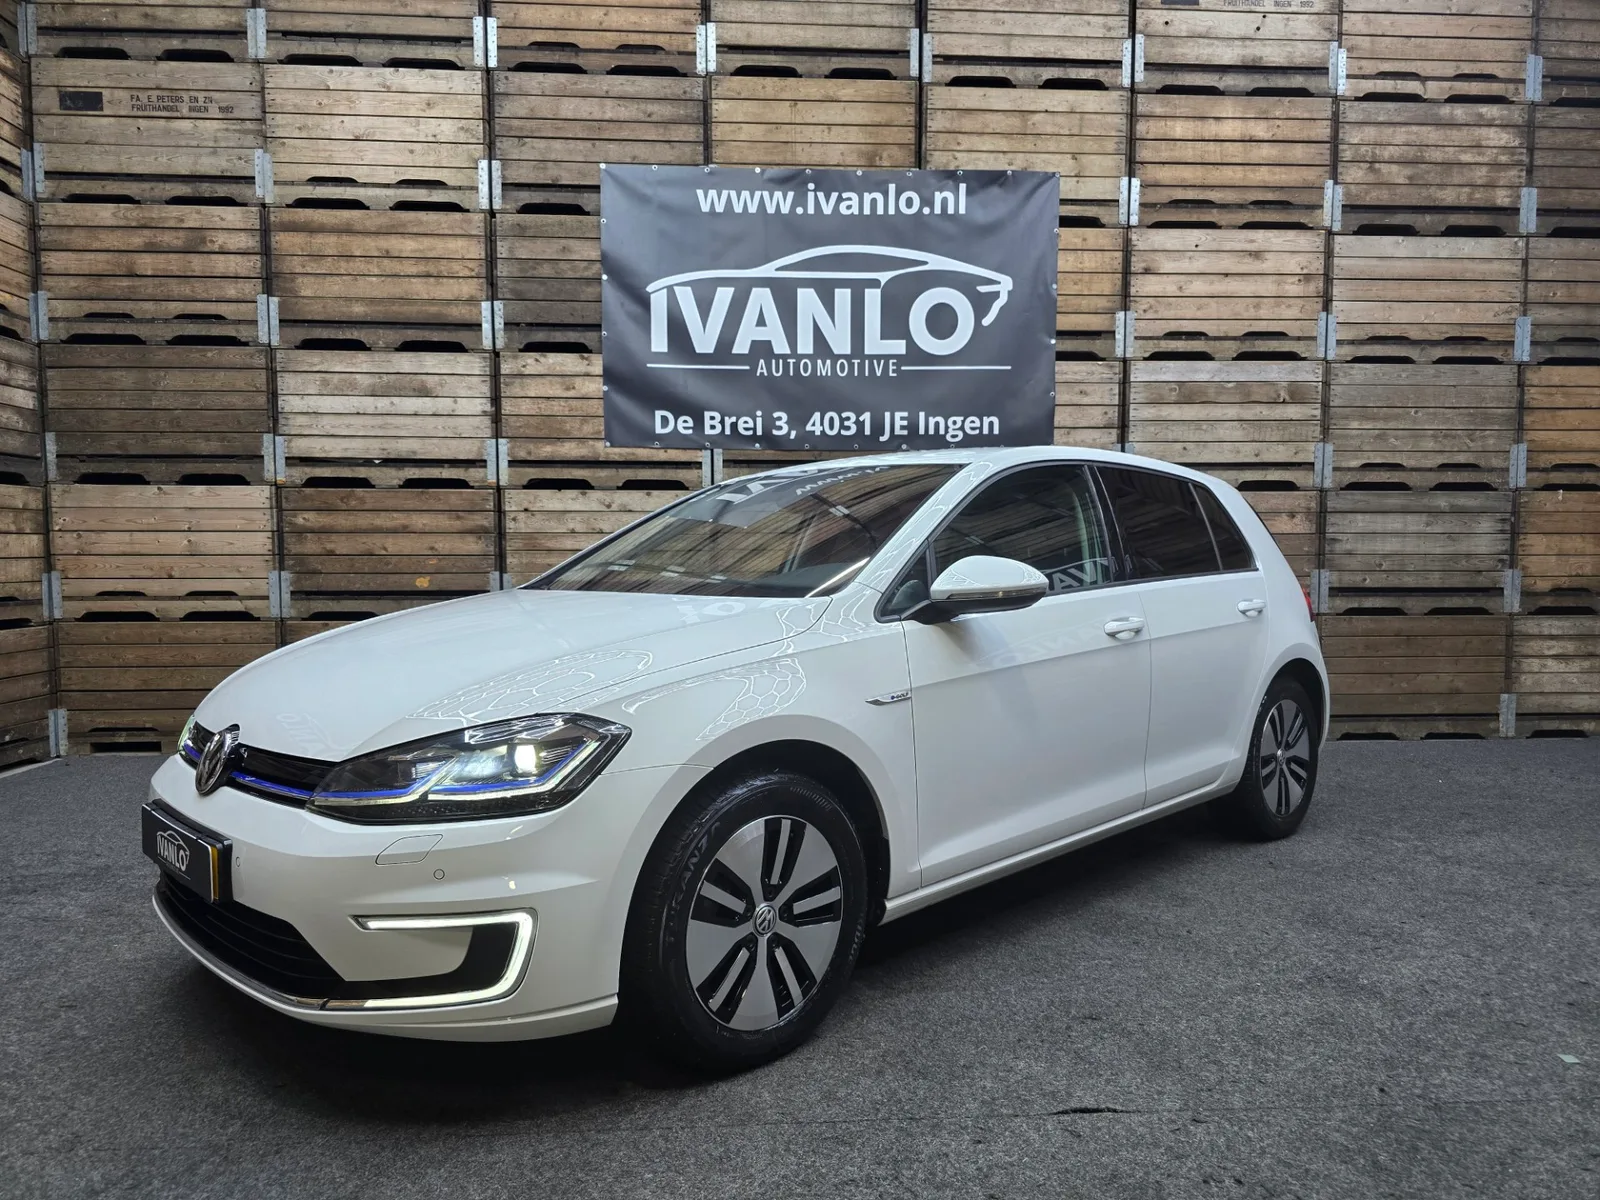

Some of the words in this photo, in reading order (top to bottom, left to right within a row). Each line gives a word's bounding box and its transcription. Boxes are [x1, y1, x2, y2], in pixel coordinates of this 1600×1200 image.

[131, 104, 180, 113] FRUITHANDEL
[188, 105, 209, 113] INGEN
[156, 94, 185, 104] PETERS
[189, 95, 199, 104] EN
[695, 183, 967, 215] www.ivanlo.nl
[650, 285, 975, 356] IVANLO
[756, 358, 898, 377] AUTOMOTIVE
[654, 410, 694, 435] De
[703, 410, 763, 436] Brei
[771, 411, 797, 440] 3,
[805, 411, 871, 436] 4031
[879, 411, 909, 442] JE
[918, 411, 1000, 443] Ingen
[156, 833, 187, 872] IVANLO
